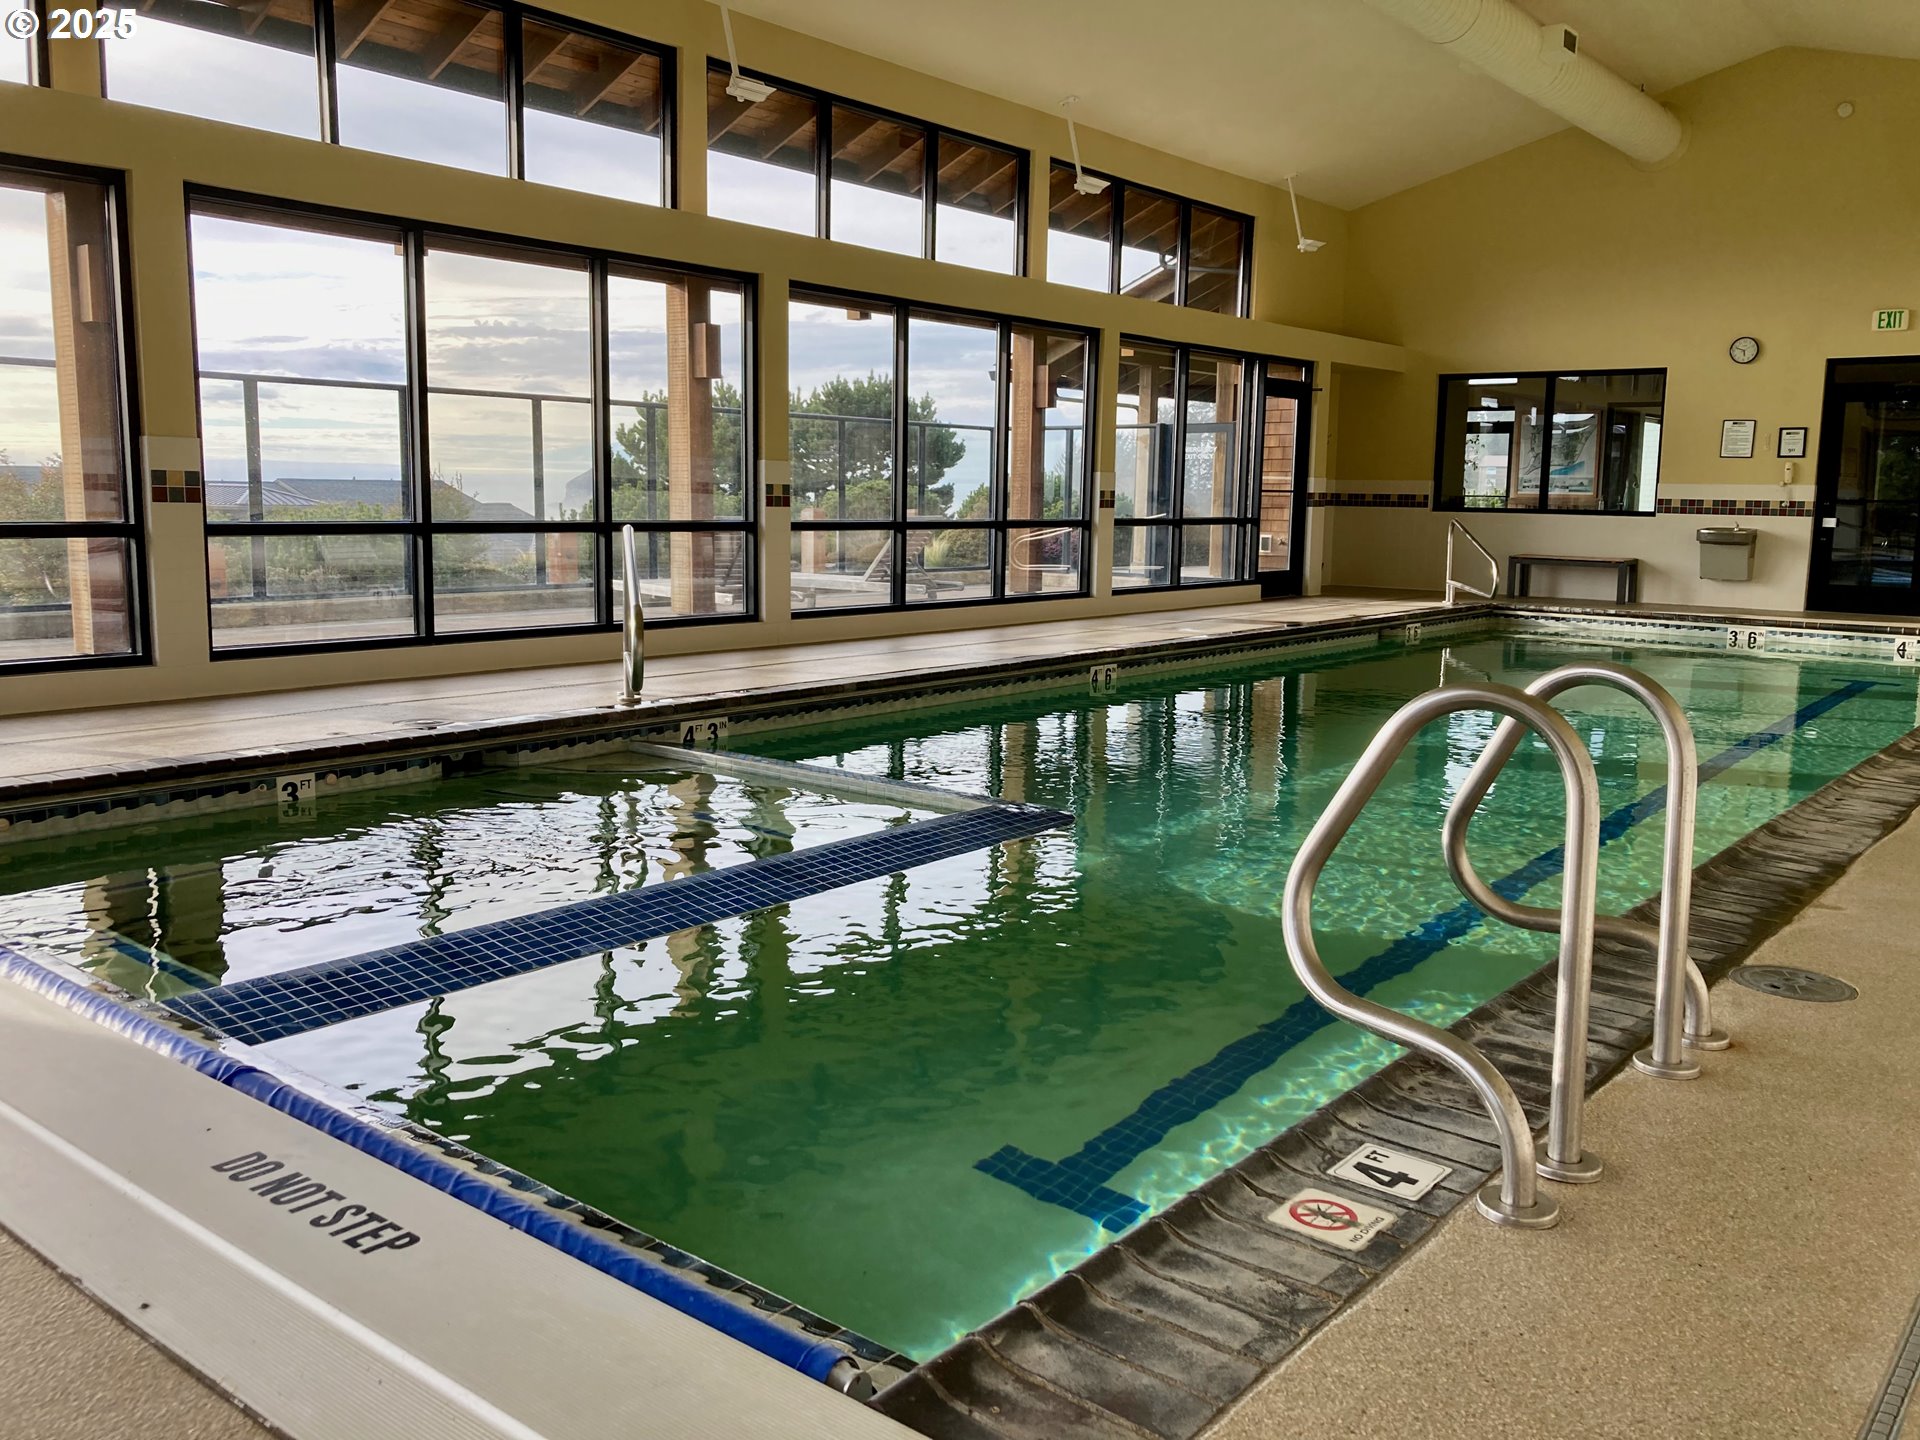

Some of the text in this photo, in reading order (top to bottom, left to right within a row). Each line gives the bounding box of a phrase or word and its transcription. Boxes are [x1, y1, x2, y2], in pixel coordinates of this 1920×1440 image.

[1877, 311, 1904, 329] EXIT
[1729, 630, 1738, 641] 3
[1896, 641, 1907, 652] 4
[1091, 669, 1099, 682] 4
[683, 720, 727, 743] 4 FT 3 IN
[281, 778, 312, 802] 3 FT
[1353, 1150, 1419, 1188] 4 FT
[210, 1150, 421, 1255] DO NOT STEP
[1349, 1216, 1385, 1244] NO DIVING
